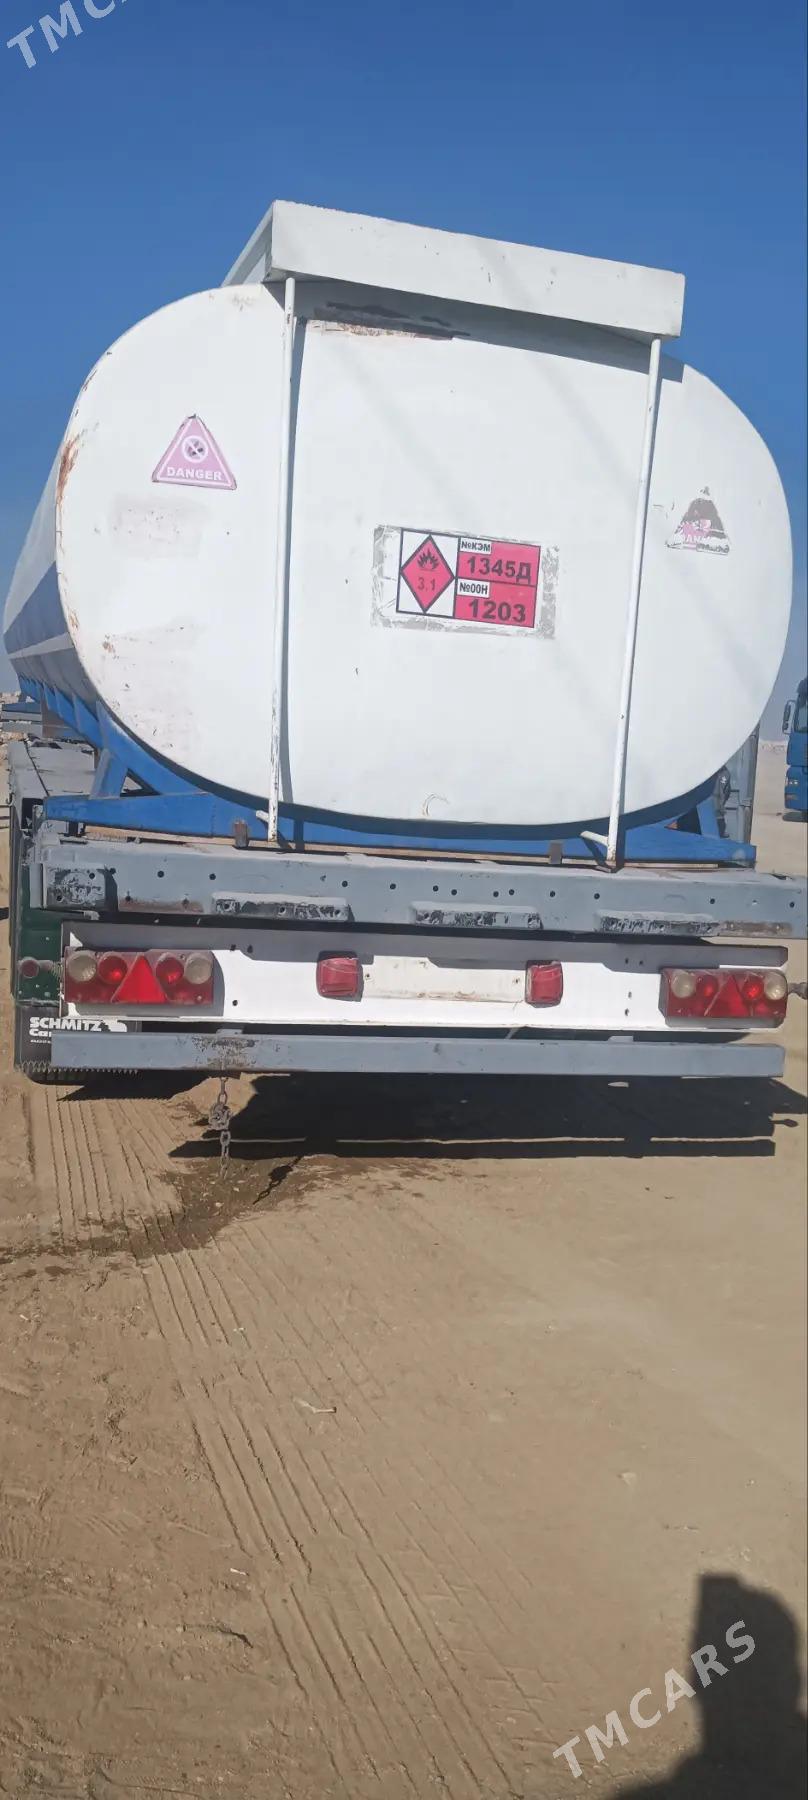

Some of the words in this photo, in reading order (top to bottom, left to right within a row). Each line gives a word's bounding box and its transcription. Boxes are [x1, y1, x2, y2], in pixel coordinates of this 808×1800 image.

[167, 467, 222, 480] DANGER
[461, 540, 491, 552] №КЭМ
[467, 556, 531, 584] 1345Д
[417, 576, 436, 591] 3.1
[469, 599, 526, 623] 1203
[29, 1016, 102, 1032] SCHMITZ
